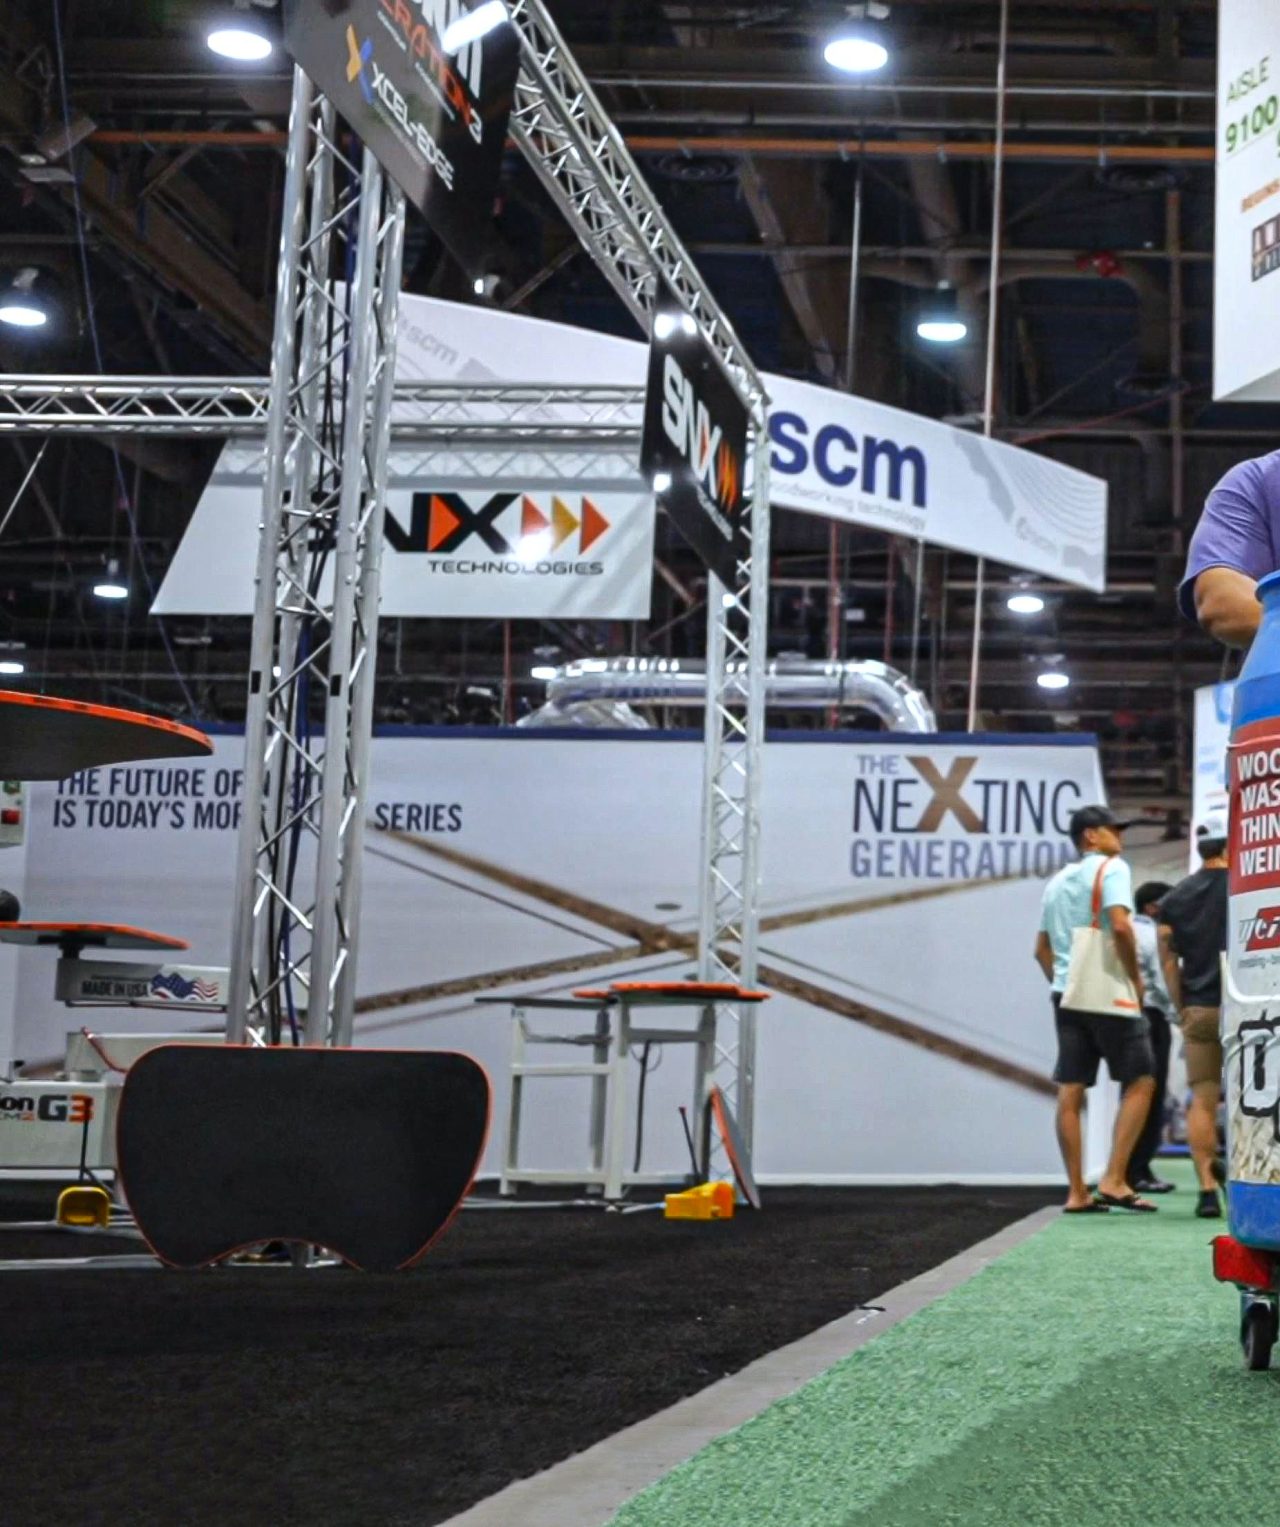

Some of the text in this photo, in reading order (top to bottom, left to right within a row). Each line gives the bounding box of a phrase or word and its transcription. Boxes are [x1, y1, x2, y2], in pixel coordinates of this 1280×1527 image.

[1226, 56, 1270, 104] AISLE
[1225, 95, 1279, 153] 9100
[768, 411, 927, 509] scm
[427, 559, 604, 575] TECHNOLOGIES
[857, 754, 900, 775] THE
[110, 769, 204, 798] FUTURE
[53, 800, 76, 829] IS
[85, 799, 185, 829] TODAY'S
[374, 802, 463, 833] SERIES
[81, 980, 114, 996] MADE
[126, 982, 150, 998] USA
